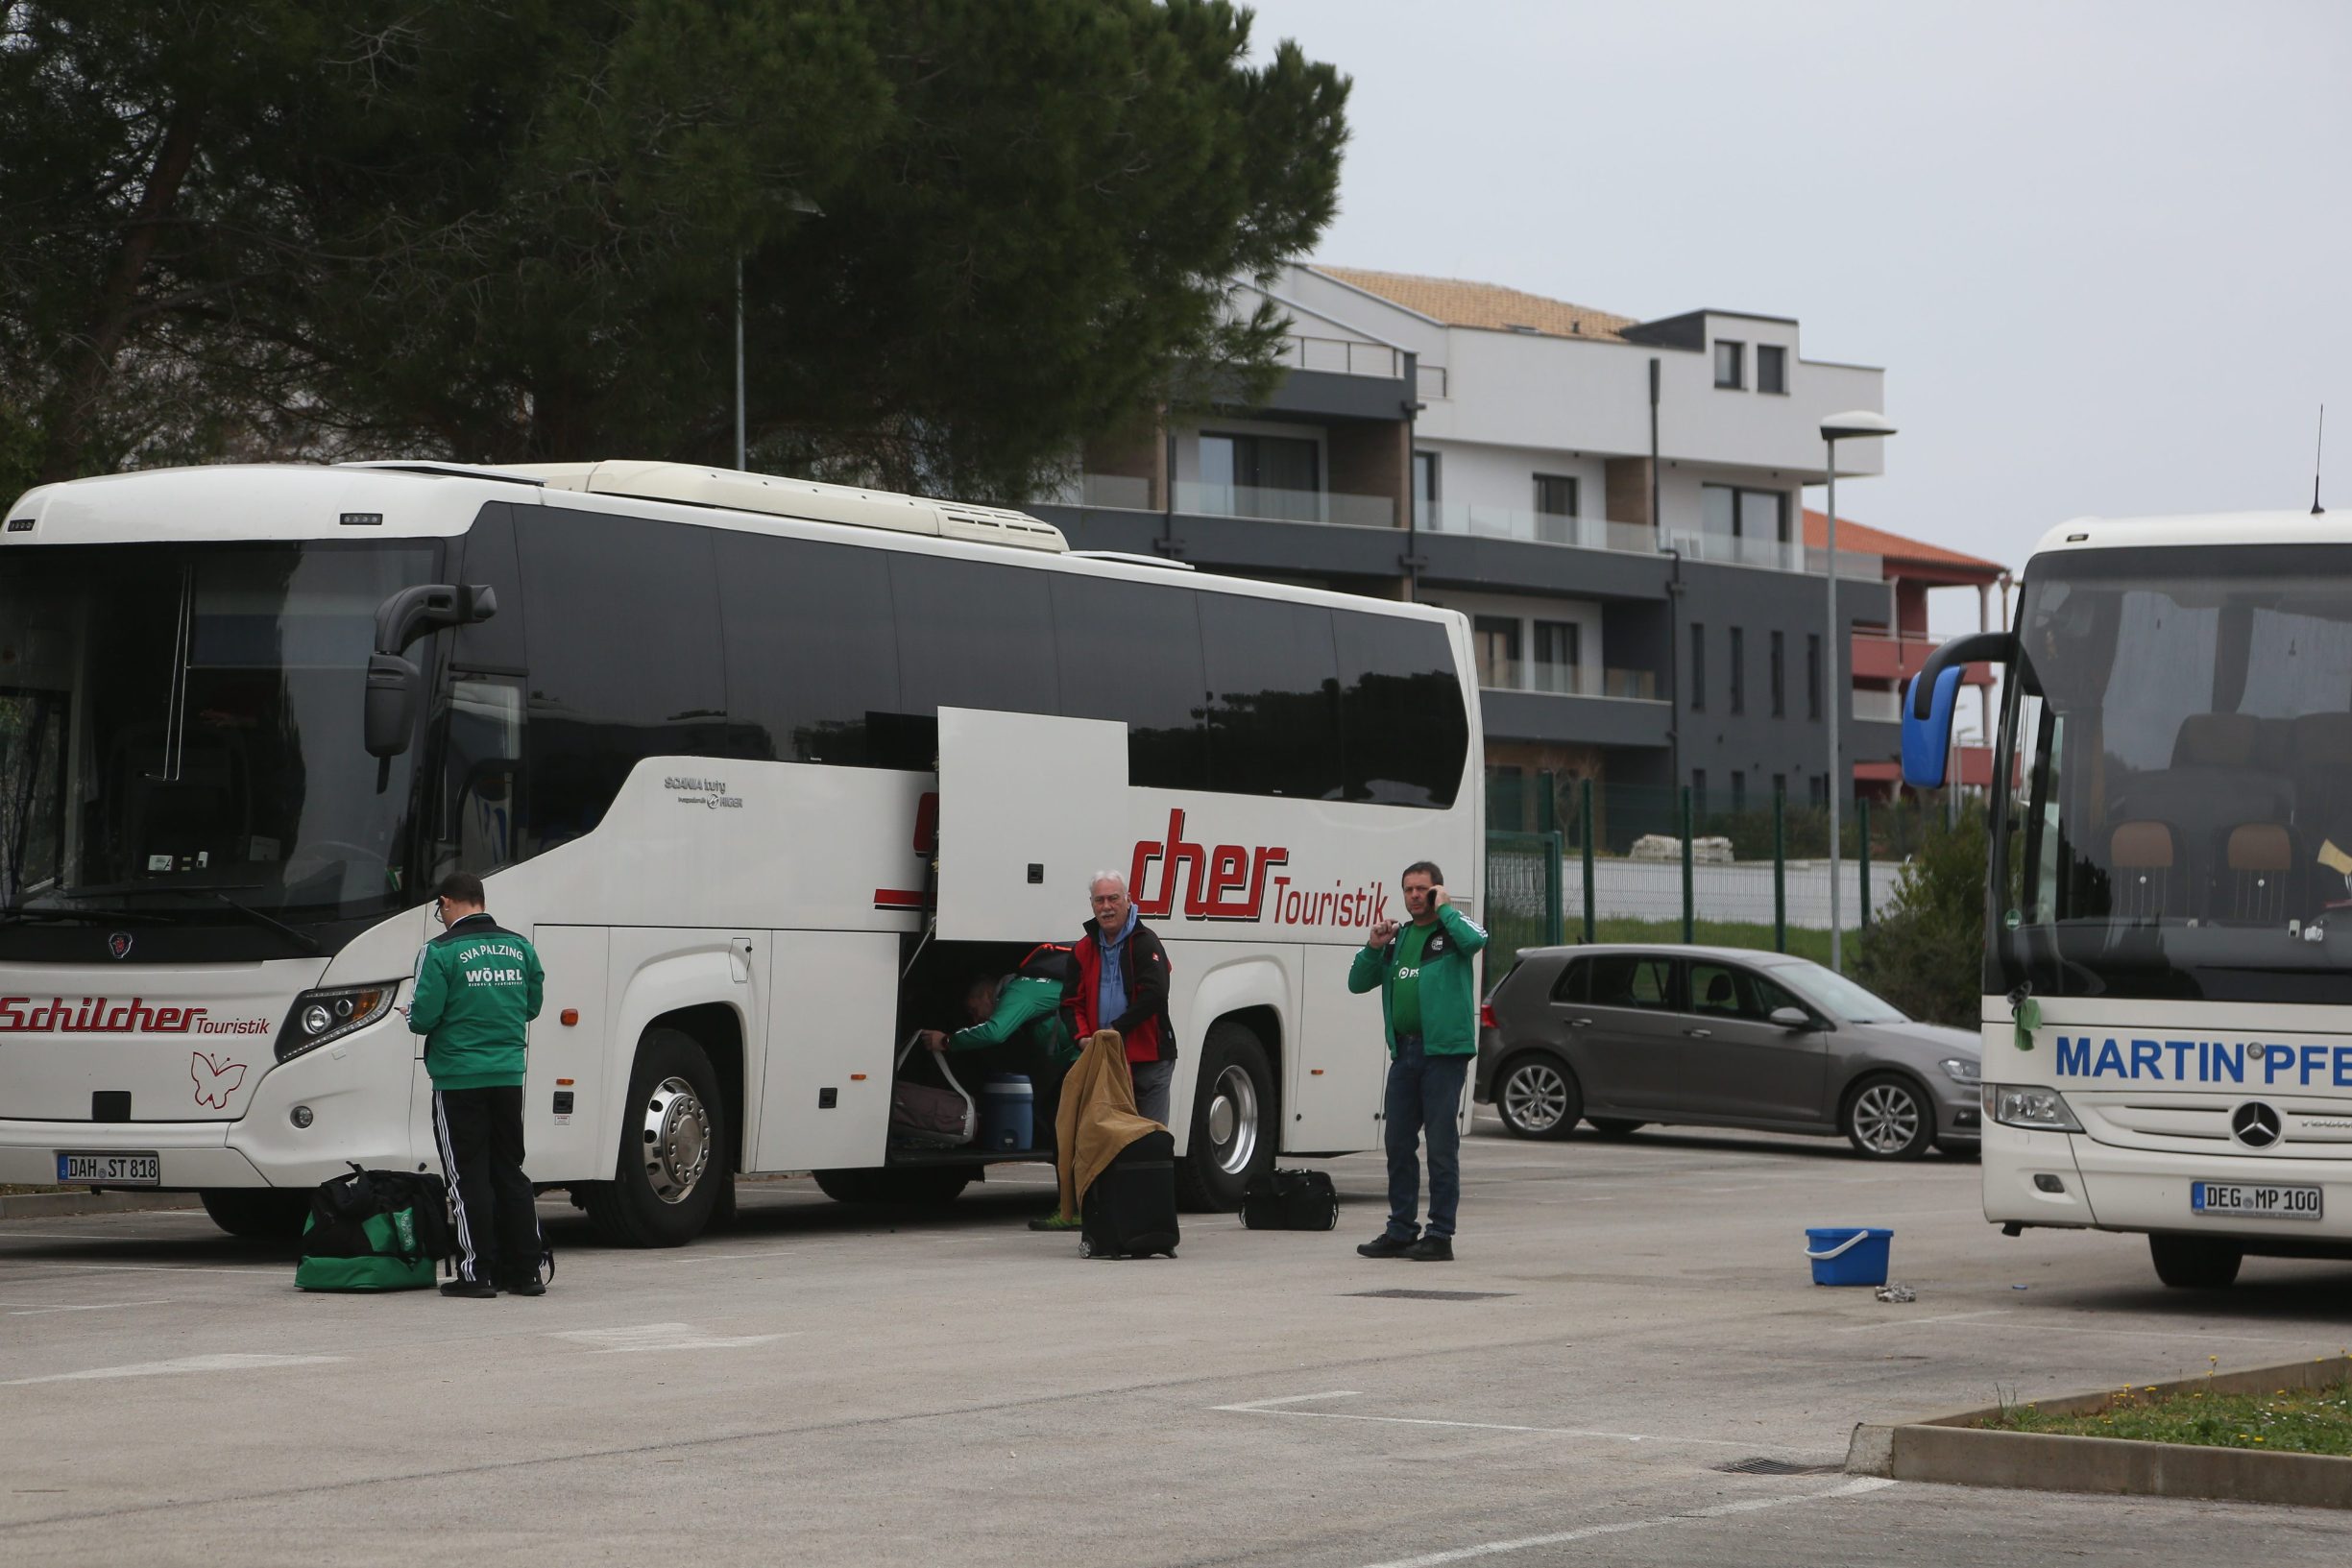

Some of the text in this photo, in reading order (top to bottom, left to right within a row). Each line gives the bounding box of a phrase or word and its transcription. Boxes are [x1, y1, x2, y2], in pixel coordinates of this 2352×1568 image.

[1274, 876, 1389, 928] Touristik
[460, 945, 523, 963] SVA PALZING
[466, 968, 522, 982] WÖHRL
[0, 997, 270, 1034] Schilcher Touristik
[2056, 1036, 2244, 1083] MARTIN
[69, 1159, 97, 1177] DAH
[109, 1158, 127, 1177] ST
[130, 1159, 158, 1178] 818
[2206, 1187, 2242, 1207] DEG
[2255, 1189, 2279, 1209] MP
[2283, 1191, 2317, 1210] 100
